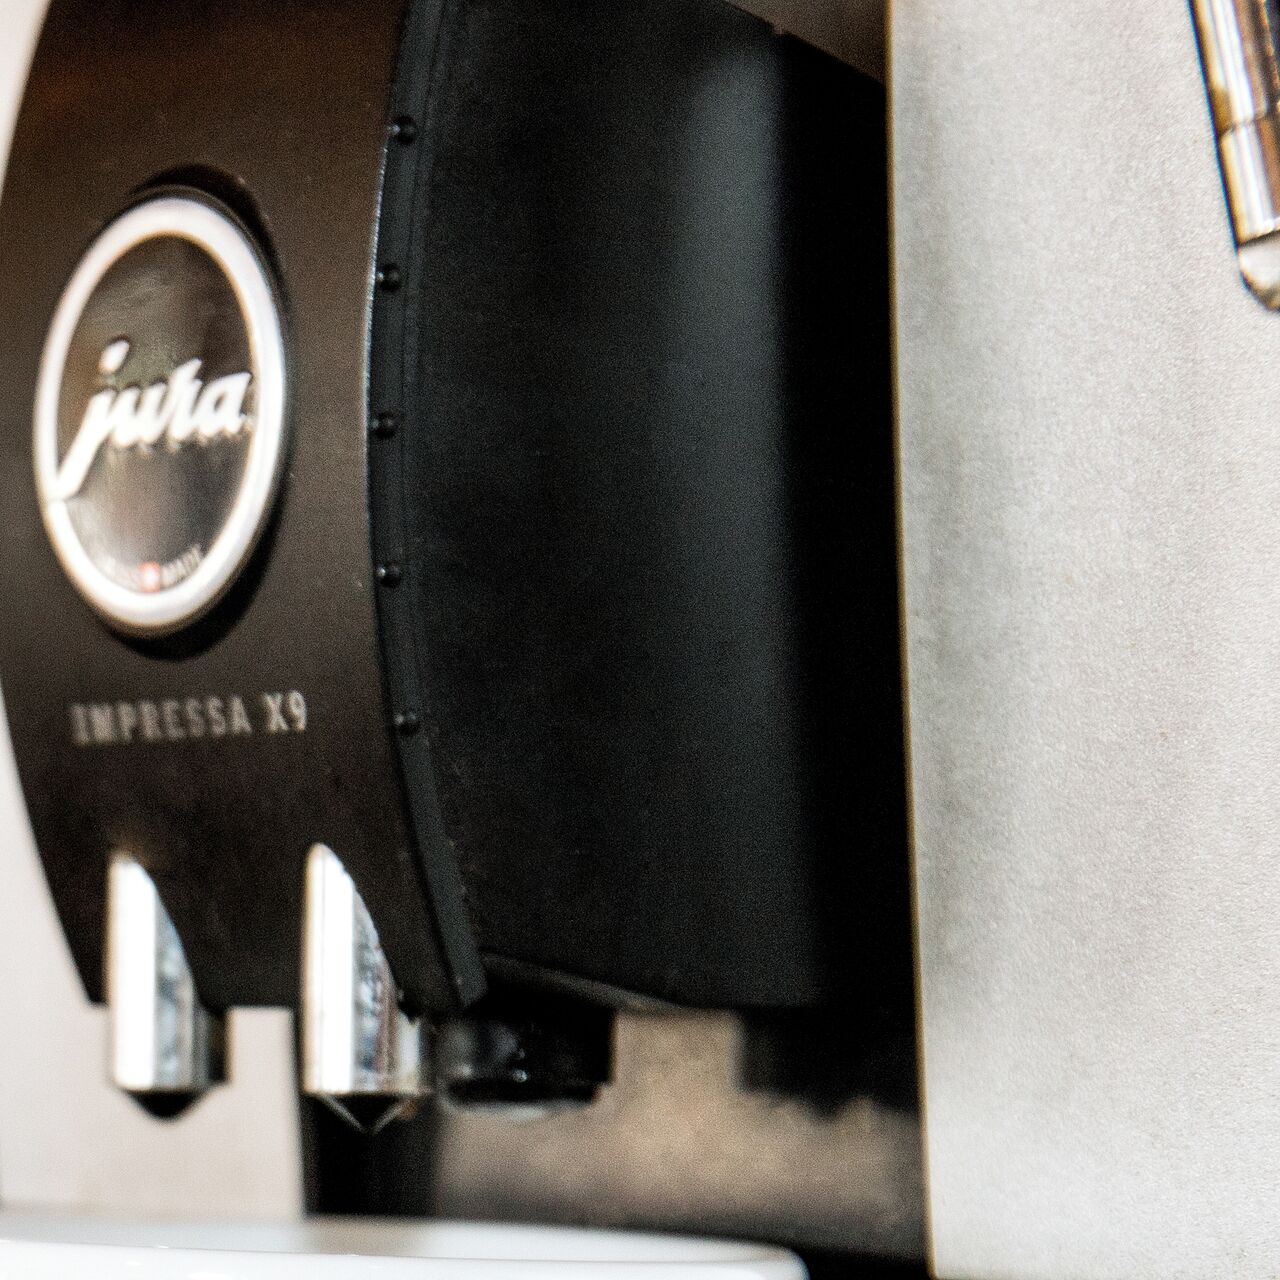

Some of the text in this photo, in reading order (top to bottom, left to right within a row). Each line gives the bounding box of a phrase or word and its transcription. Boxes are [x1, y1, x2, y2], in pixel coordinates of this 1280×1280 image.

[50, 339, 252, 500] jura
[71, 690, 307, 744] IMPRESSA X9
